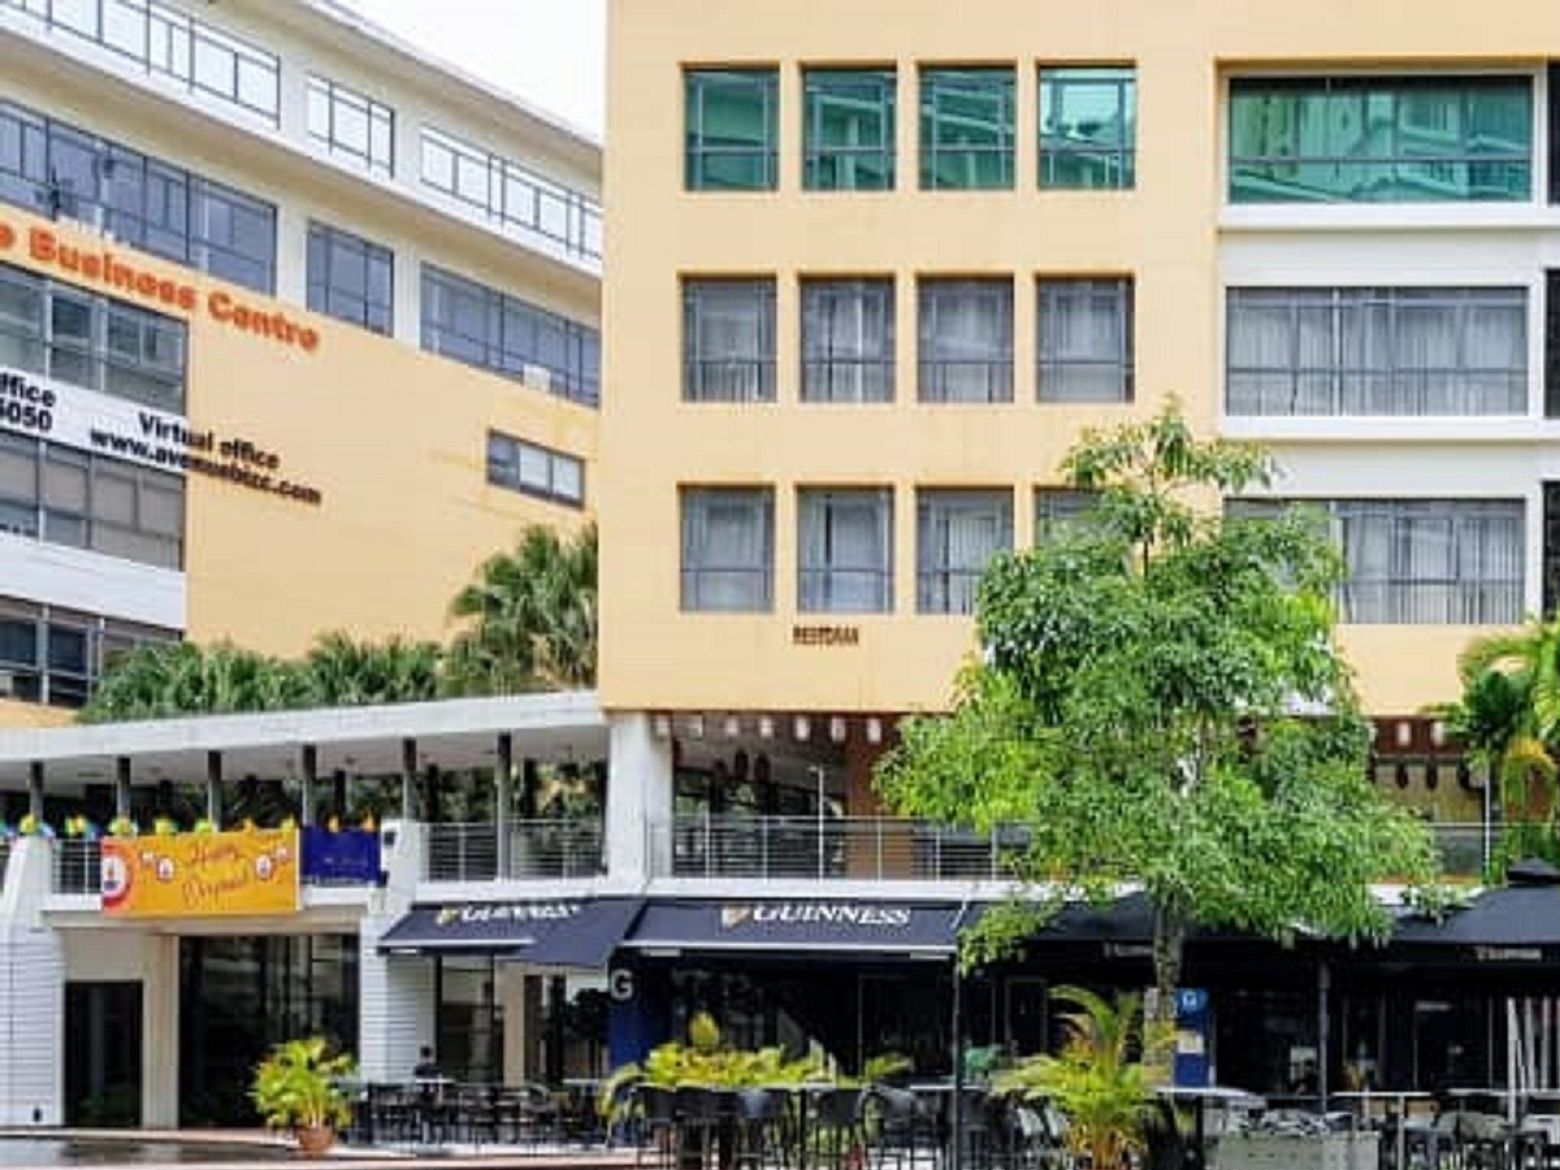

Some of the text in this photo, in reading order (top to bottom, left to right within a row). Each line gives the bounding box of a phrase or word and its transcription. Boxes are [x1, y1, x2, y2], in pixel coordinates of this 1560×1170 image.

[29, 225, 197, 310] Business
[207, 289, 319, 350] Centre
[0, 372, 57, 408] ffice
[0, 397, 53, 434] 050
[138, 411, 281, 470] Virtual office
[752, 904, 912, 925] GUINNESS
